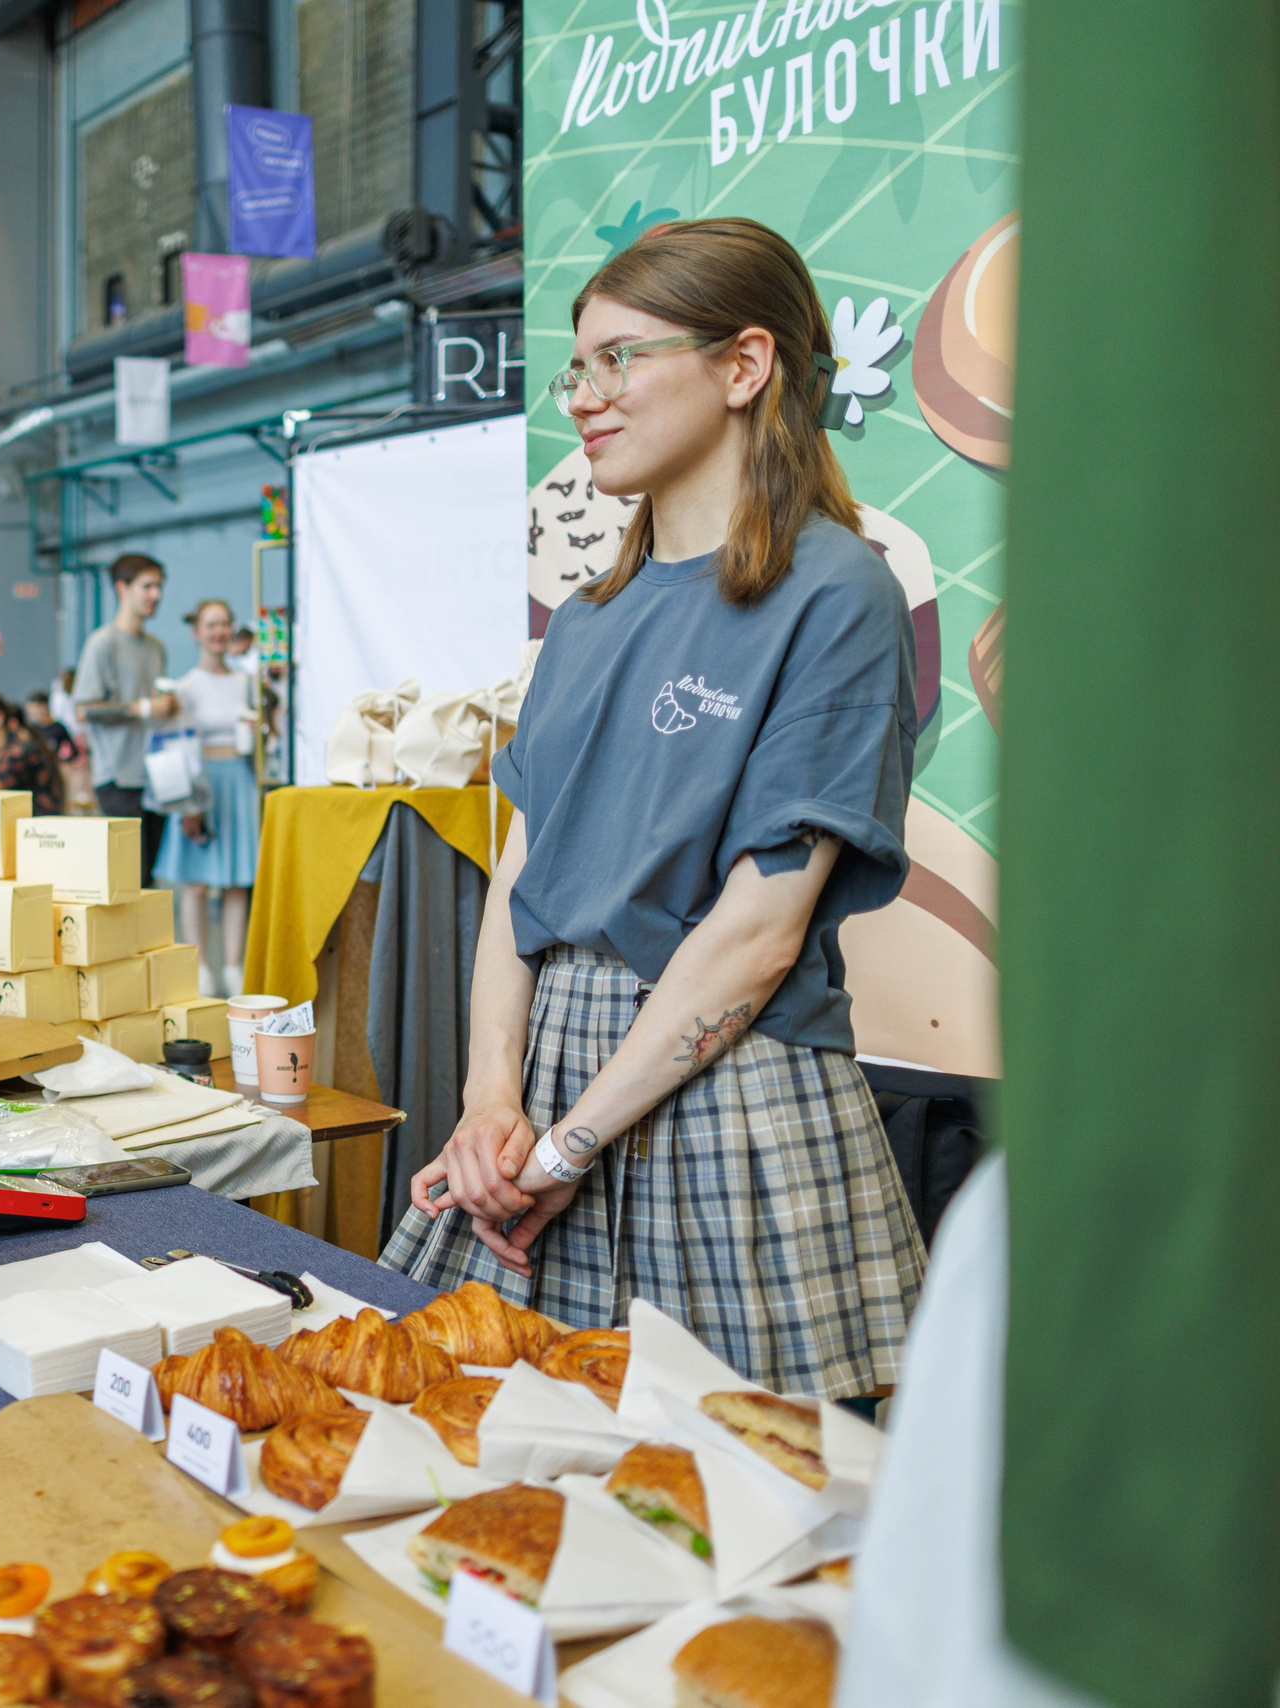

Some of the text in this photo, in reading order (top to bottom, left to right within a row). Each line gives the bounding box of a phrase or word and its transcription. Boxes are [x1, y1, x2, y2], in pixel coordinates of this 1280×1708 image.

[710, 0, 1001, 167] БУЛОЧКИ
[675, 674, 739, 705] Подписные
[698, 699, 743, 720] БУЛОЧКИ
[110, 1373, 131, 1398] 200
[187, 1421, 212, 1450] 400
